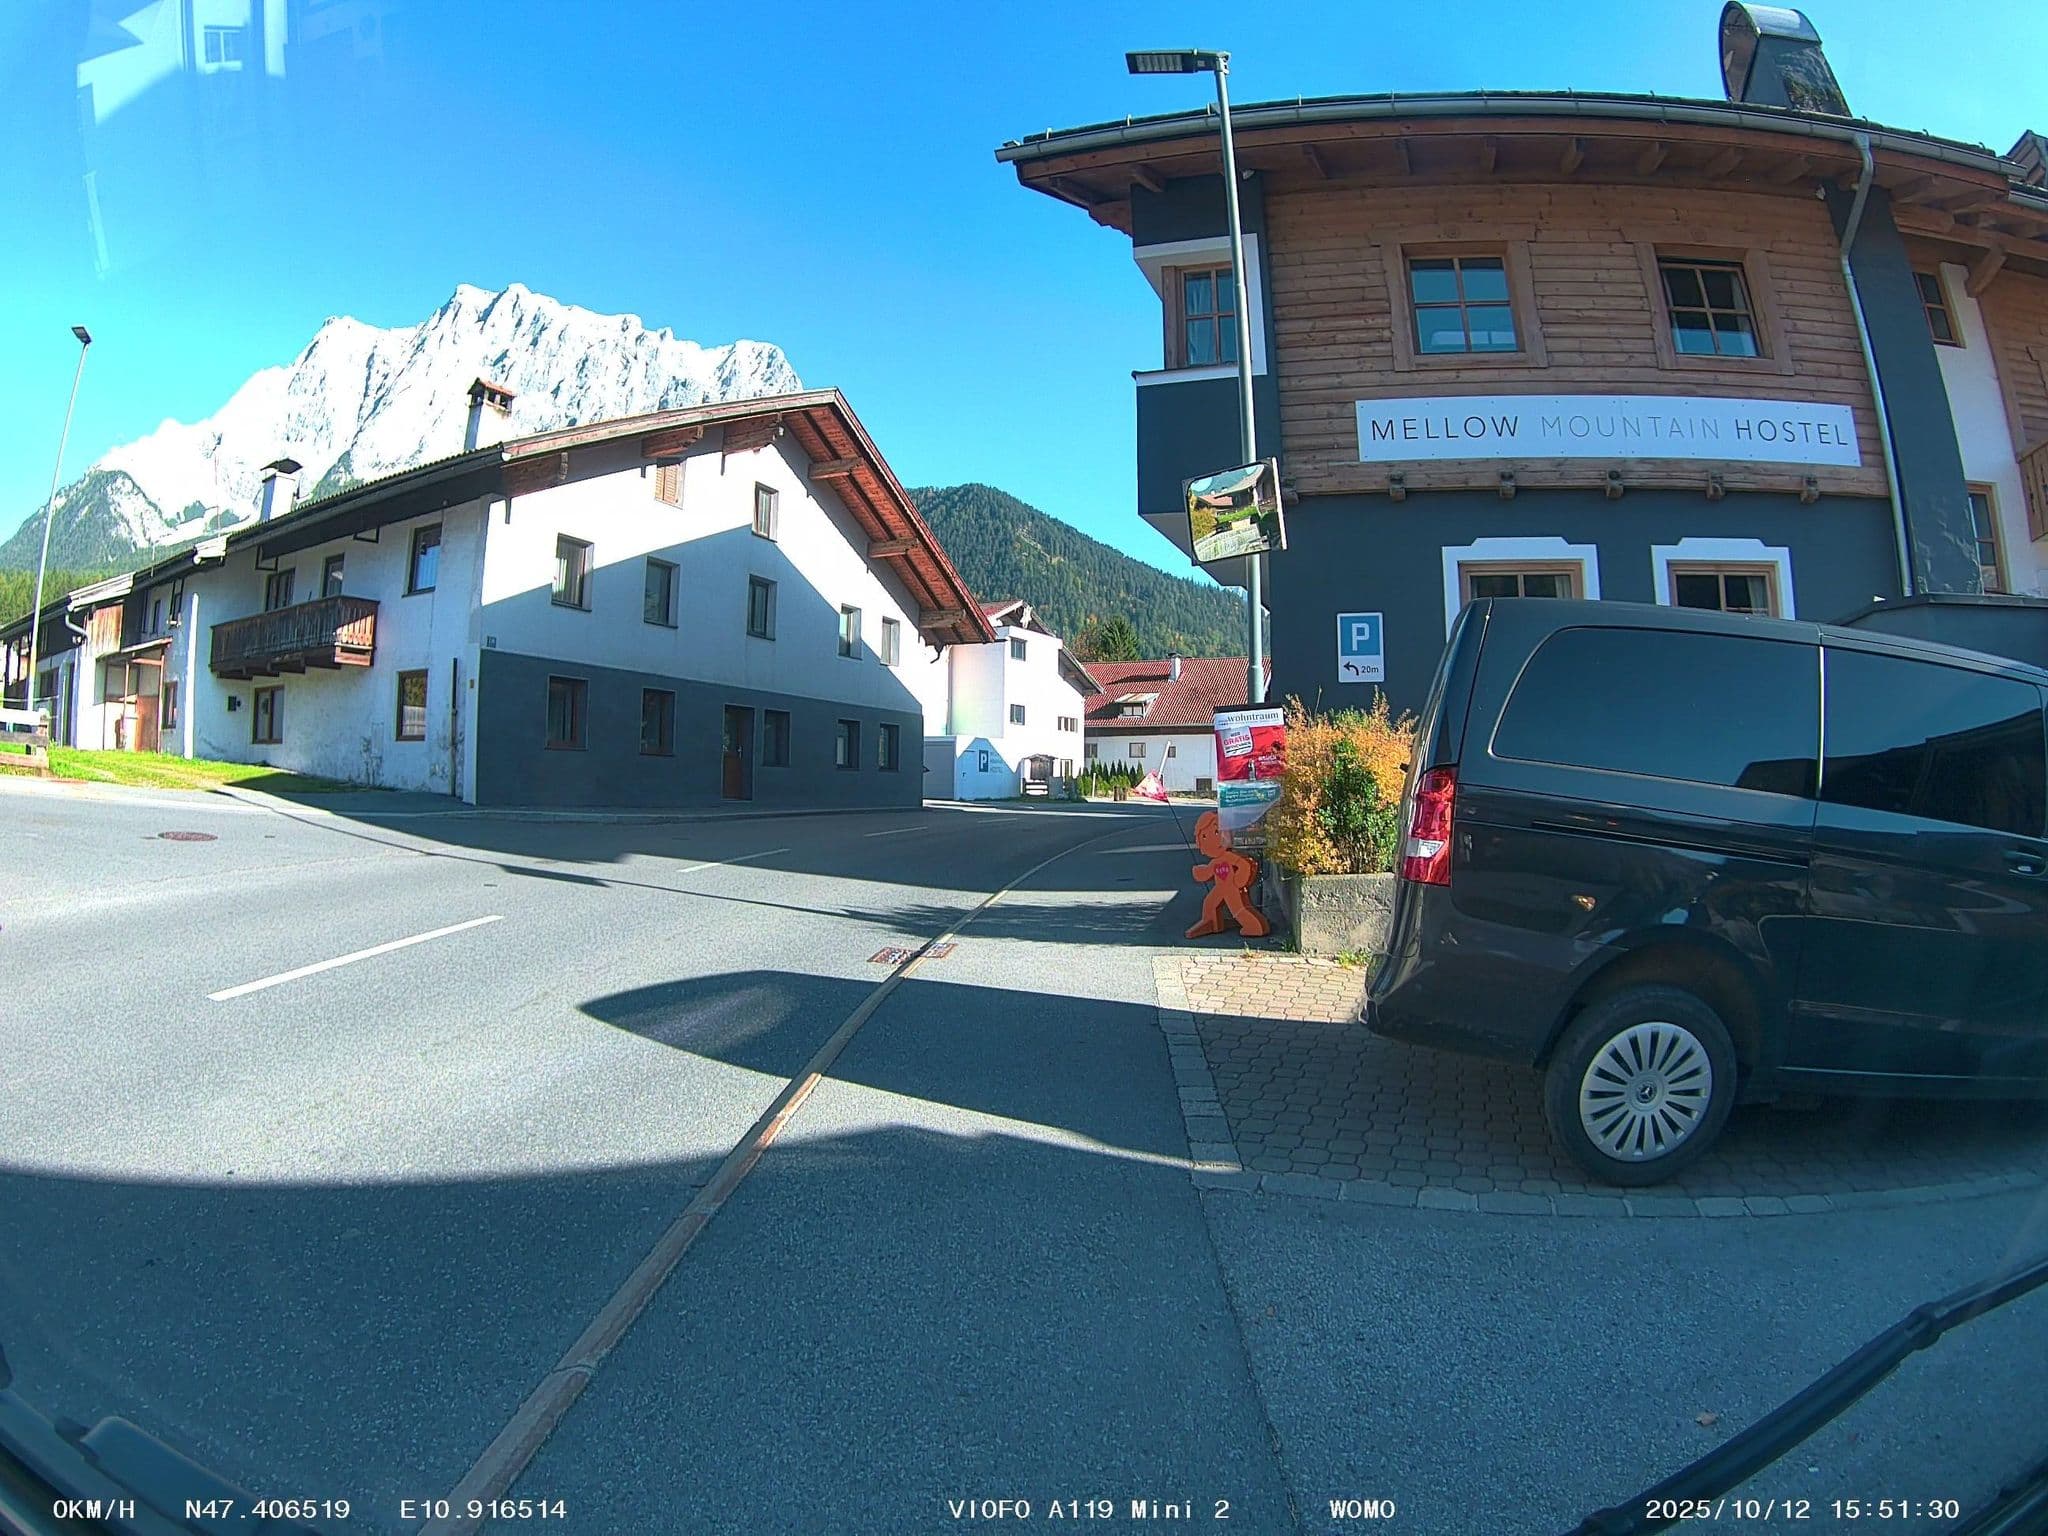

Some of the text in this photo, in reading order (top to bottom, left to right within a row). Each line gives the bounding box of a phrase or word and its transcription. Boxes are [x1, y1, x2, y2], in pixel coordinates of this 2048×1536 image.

[1371, 415, 1849, 446] MELLOW MOUNTAIN HOSTEL
[1351, 622, 1370, 652] P
[1361, 665, 1379, 673] 20m
[1227, 712, 1279, 722] wohntraum
[1223, 734, 1251, 746] GRATIS
[980, 753, 988, 769] P
